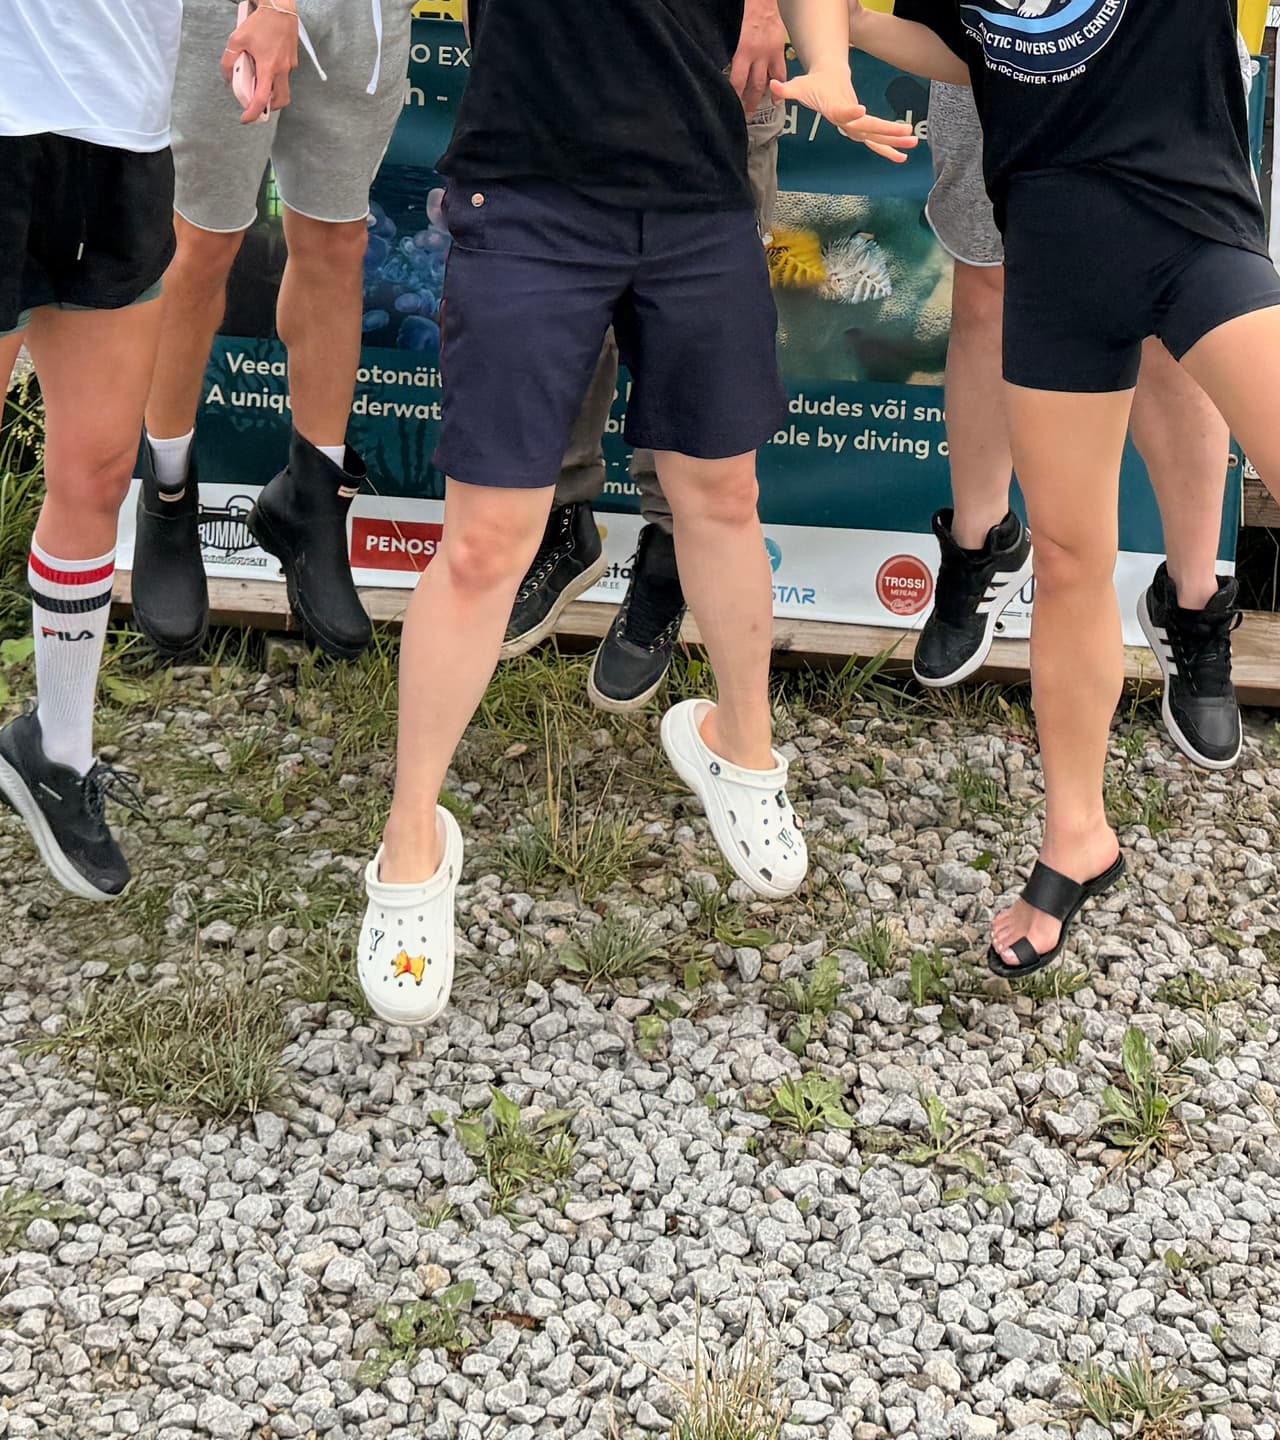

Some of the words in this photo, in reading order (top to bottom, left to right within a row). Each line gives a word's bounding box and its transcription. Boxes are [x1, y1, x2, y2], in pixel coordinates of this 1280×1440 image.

[1015, 37, 1057, 56] DIVERS
[1058, 31, 1085, 52] DIVE
[998, 63, 1012, 77] IDC
[1013, 71, 1048, 85] CENTER
[1052, 64, 1087, 85] FINLAND
[225, 351, 288, 377] Veea
[788, 393, 864, 417] dudes
[869, 398, 908, 420] või
[205, 384, 225, 406] A
[817, 426, 848, 454] by
[853, 429, 930, 460] diving
[884, 576, 925, 589] TROSSI
[41, 626, 95, 643] FILA
